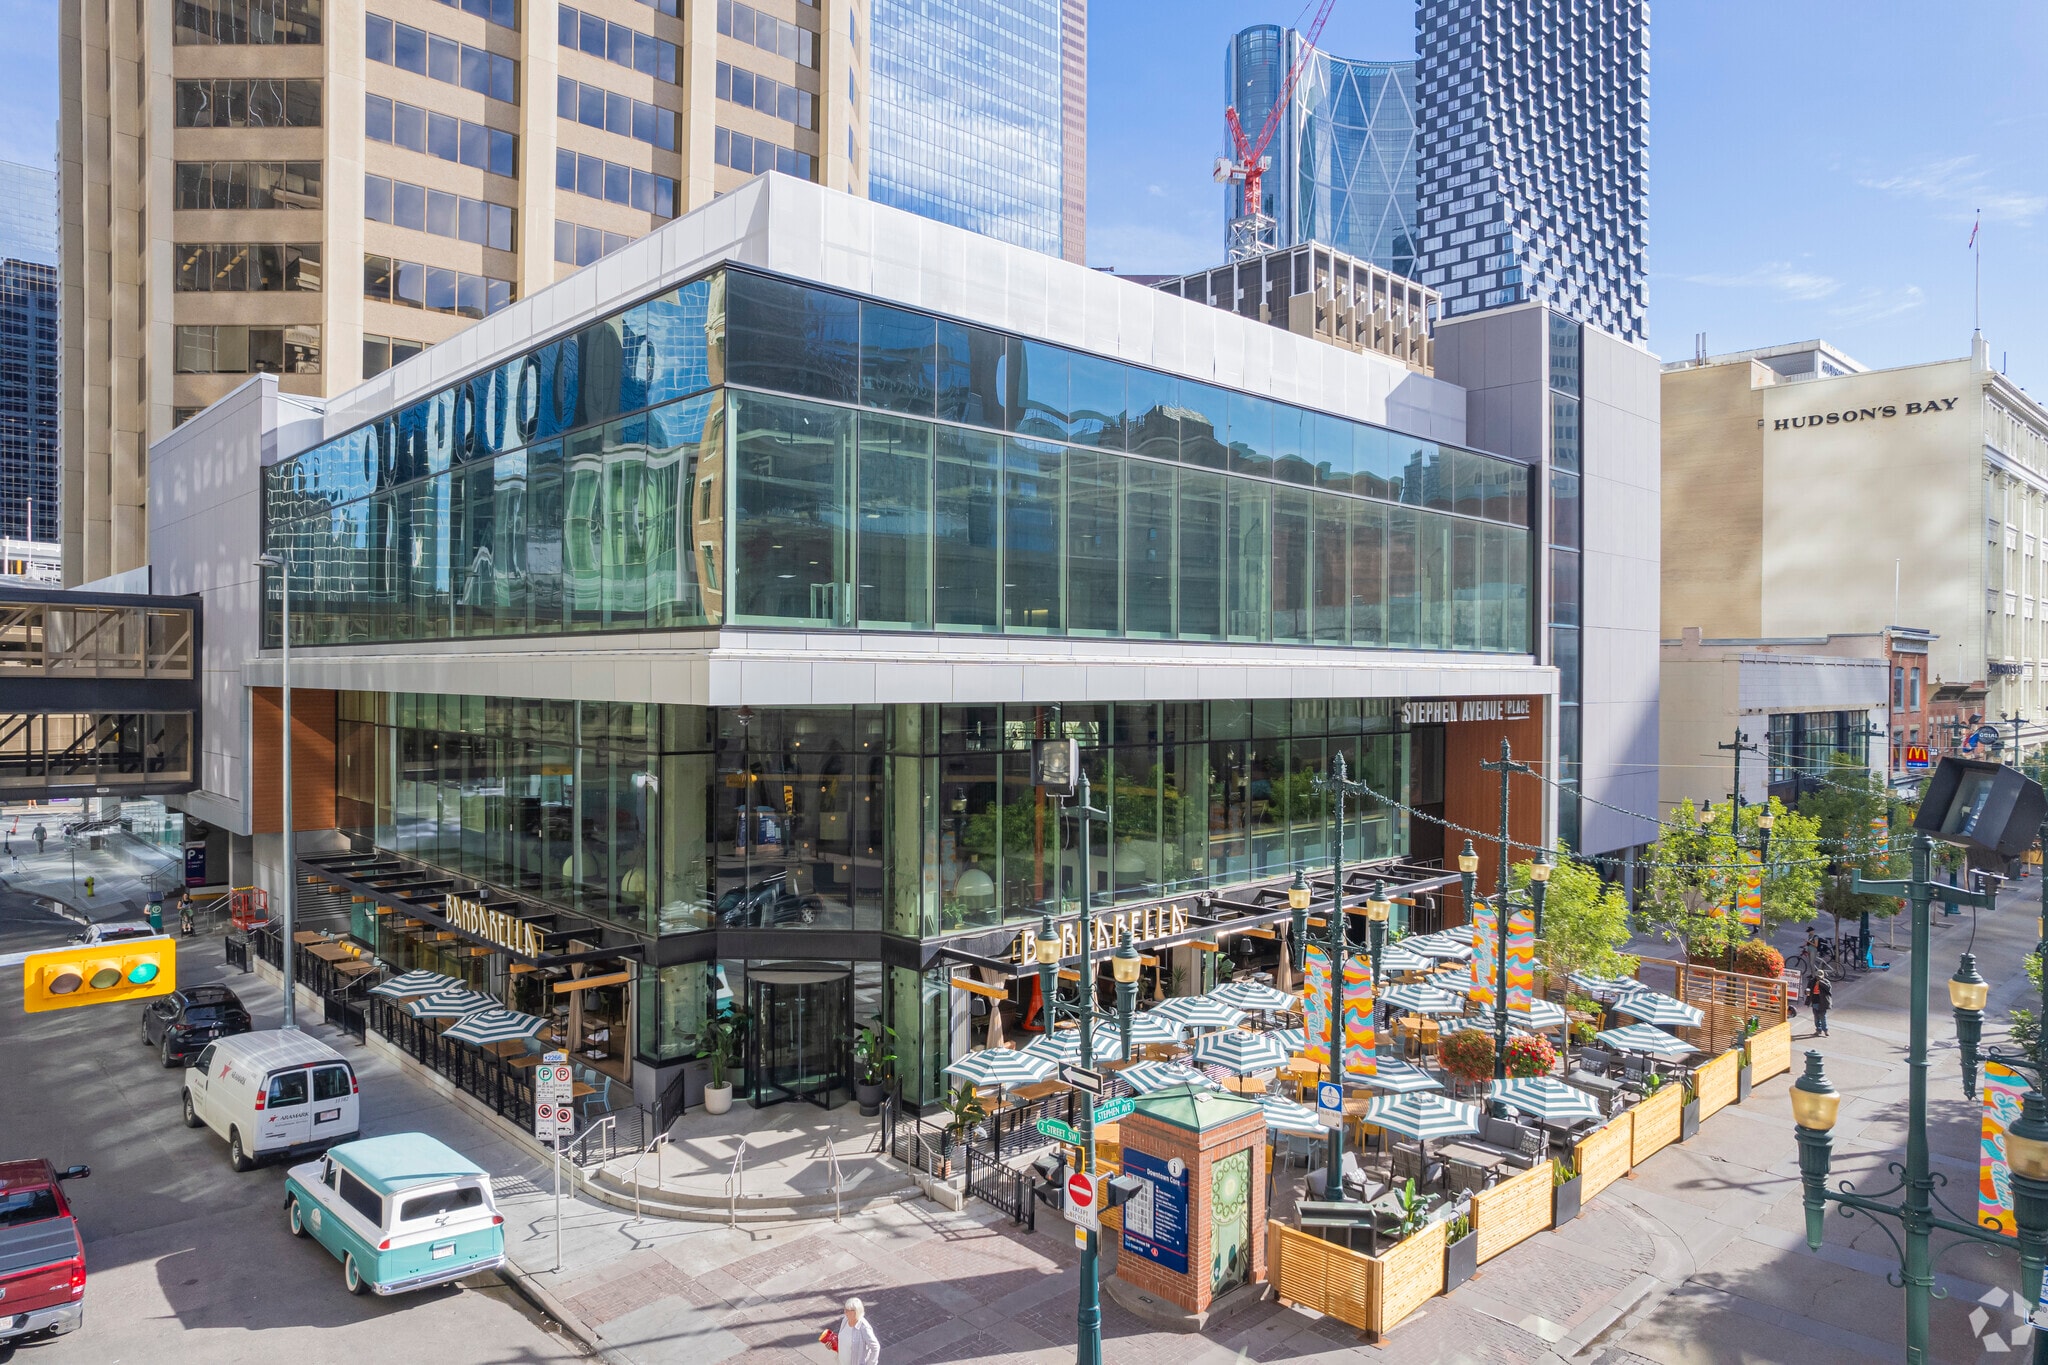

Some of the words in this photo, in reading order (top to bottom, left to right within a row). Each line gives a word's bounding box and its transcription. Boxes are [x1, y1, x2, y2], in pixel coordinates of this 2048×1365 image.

[1773, 405, 1897, 431] HUDSON'S
[1905, 397, 1959, 416] BAY
[1402, 701, 1458, 724] STEPHEN
[1461, 700, 1503, 722] AVENUE
[1504, 699, 1530, 714] PLACE
[445, 893, 538, 959] BARBARELLA
[1021, 903, 1185, 966] BRARELLA
[280, 1112, 309, 1121] ARAMARK
[1097, 1106, 1120, 1121] STEPHEN
[1121, 1101, 1131, 1113] AVE
[1040, 1122, 1045, 1131] 2
[1046, 1125, 1066, 1139] STREET
[1068, 1132, 1078, 1142] SW
[1146, 1168, 1170, 1182] Downtown
[1170, 1176, 1180, 1186] Core
[1072, 1205, 1089, 1216] EXCEPT
